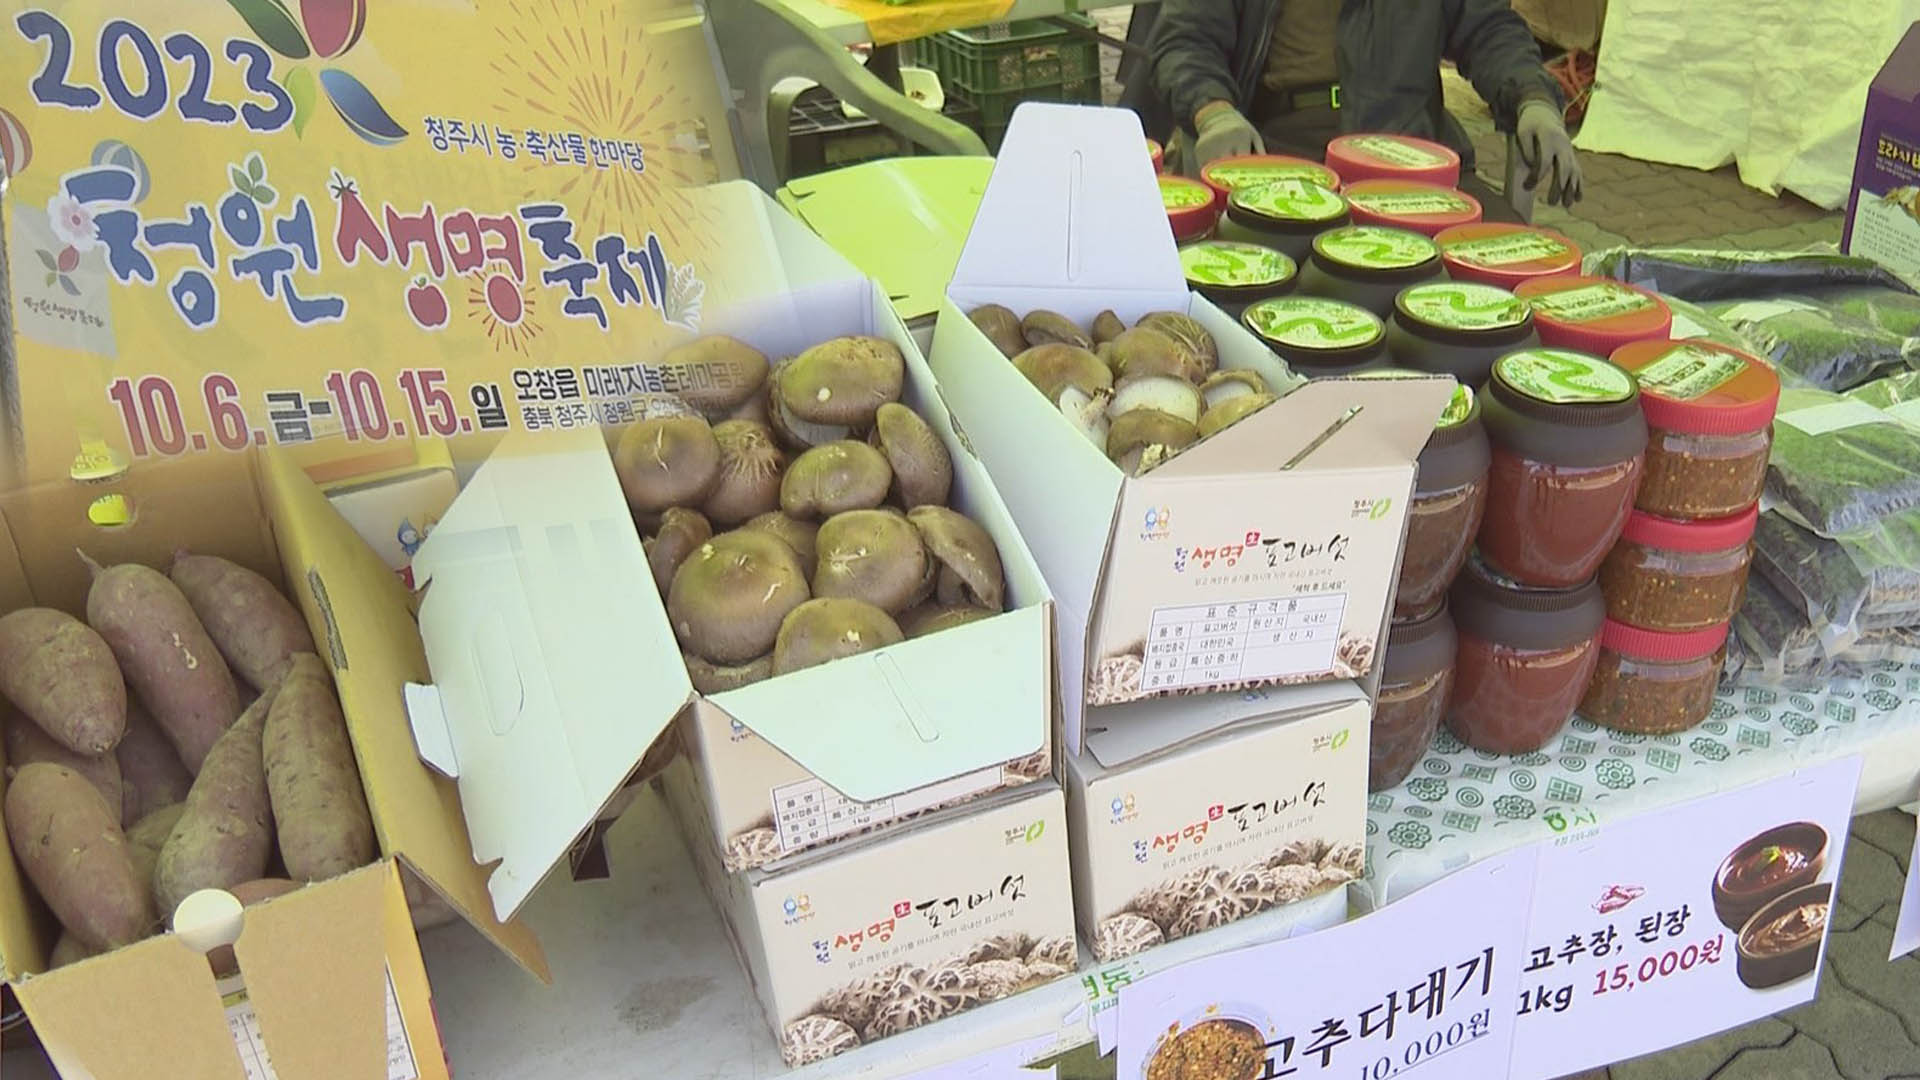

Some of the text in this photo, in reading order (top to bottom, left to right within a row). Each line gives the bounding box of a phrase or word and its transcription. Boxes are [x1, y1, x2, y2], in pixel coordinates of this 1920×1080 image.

[16, 10, 295, 132] 2023
[423, 115, 492, 156] 청주시
[588, 136, 645, 172] 한마당
[513, 367, 581, 401] 오창읍
[521, 403, 554, 430] 충북
[555, 401, 601, 428] 청주시
[602, 399, 648, 425] 청원구
[1191, 544, 1244, 569] 생명
[1262, 533, 1350, 568] 표고버섯
[1152, 819, 1209, 853] 생명
[1227, 780, 1326, 833] 표고버섯
[834, 918, 896, 953] 생명
[915, 874, 1027, 929] 표고버섯
[1522, 903, 1692, 974] 고추장, 된장
[1515, 932, 1724, 1016] 1kg 15,000원
[1257, 945, 1495, 1080] 고추다대기
